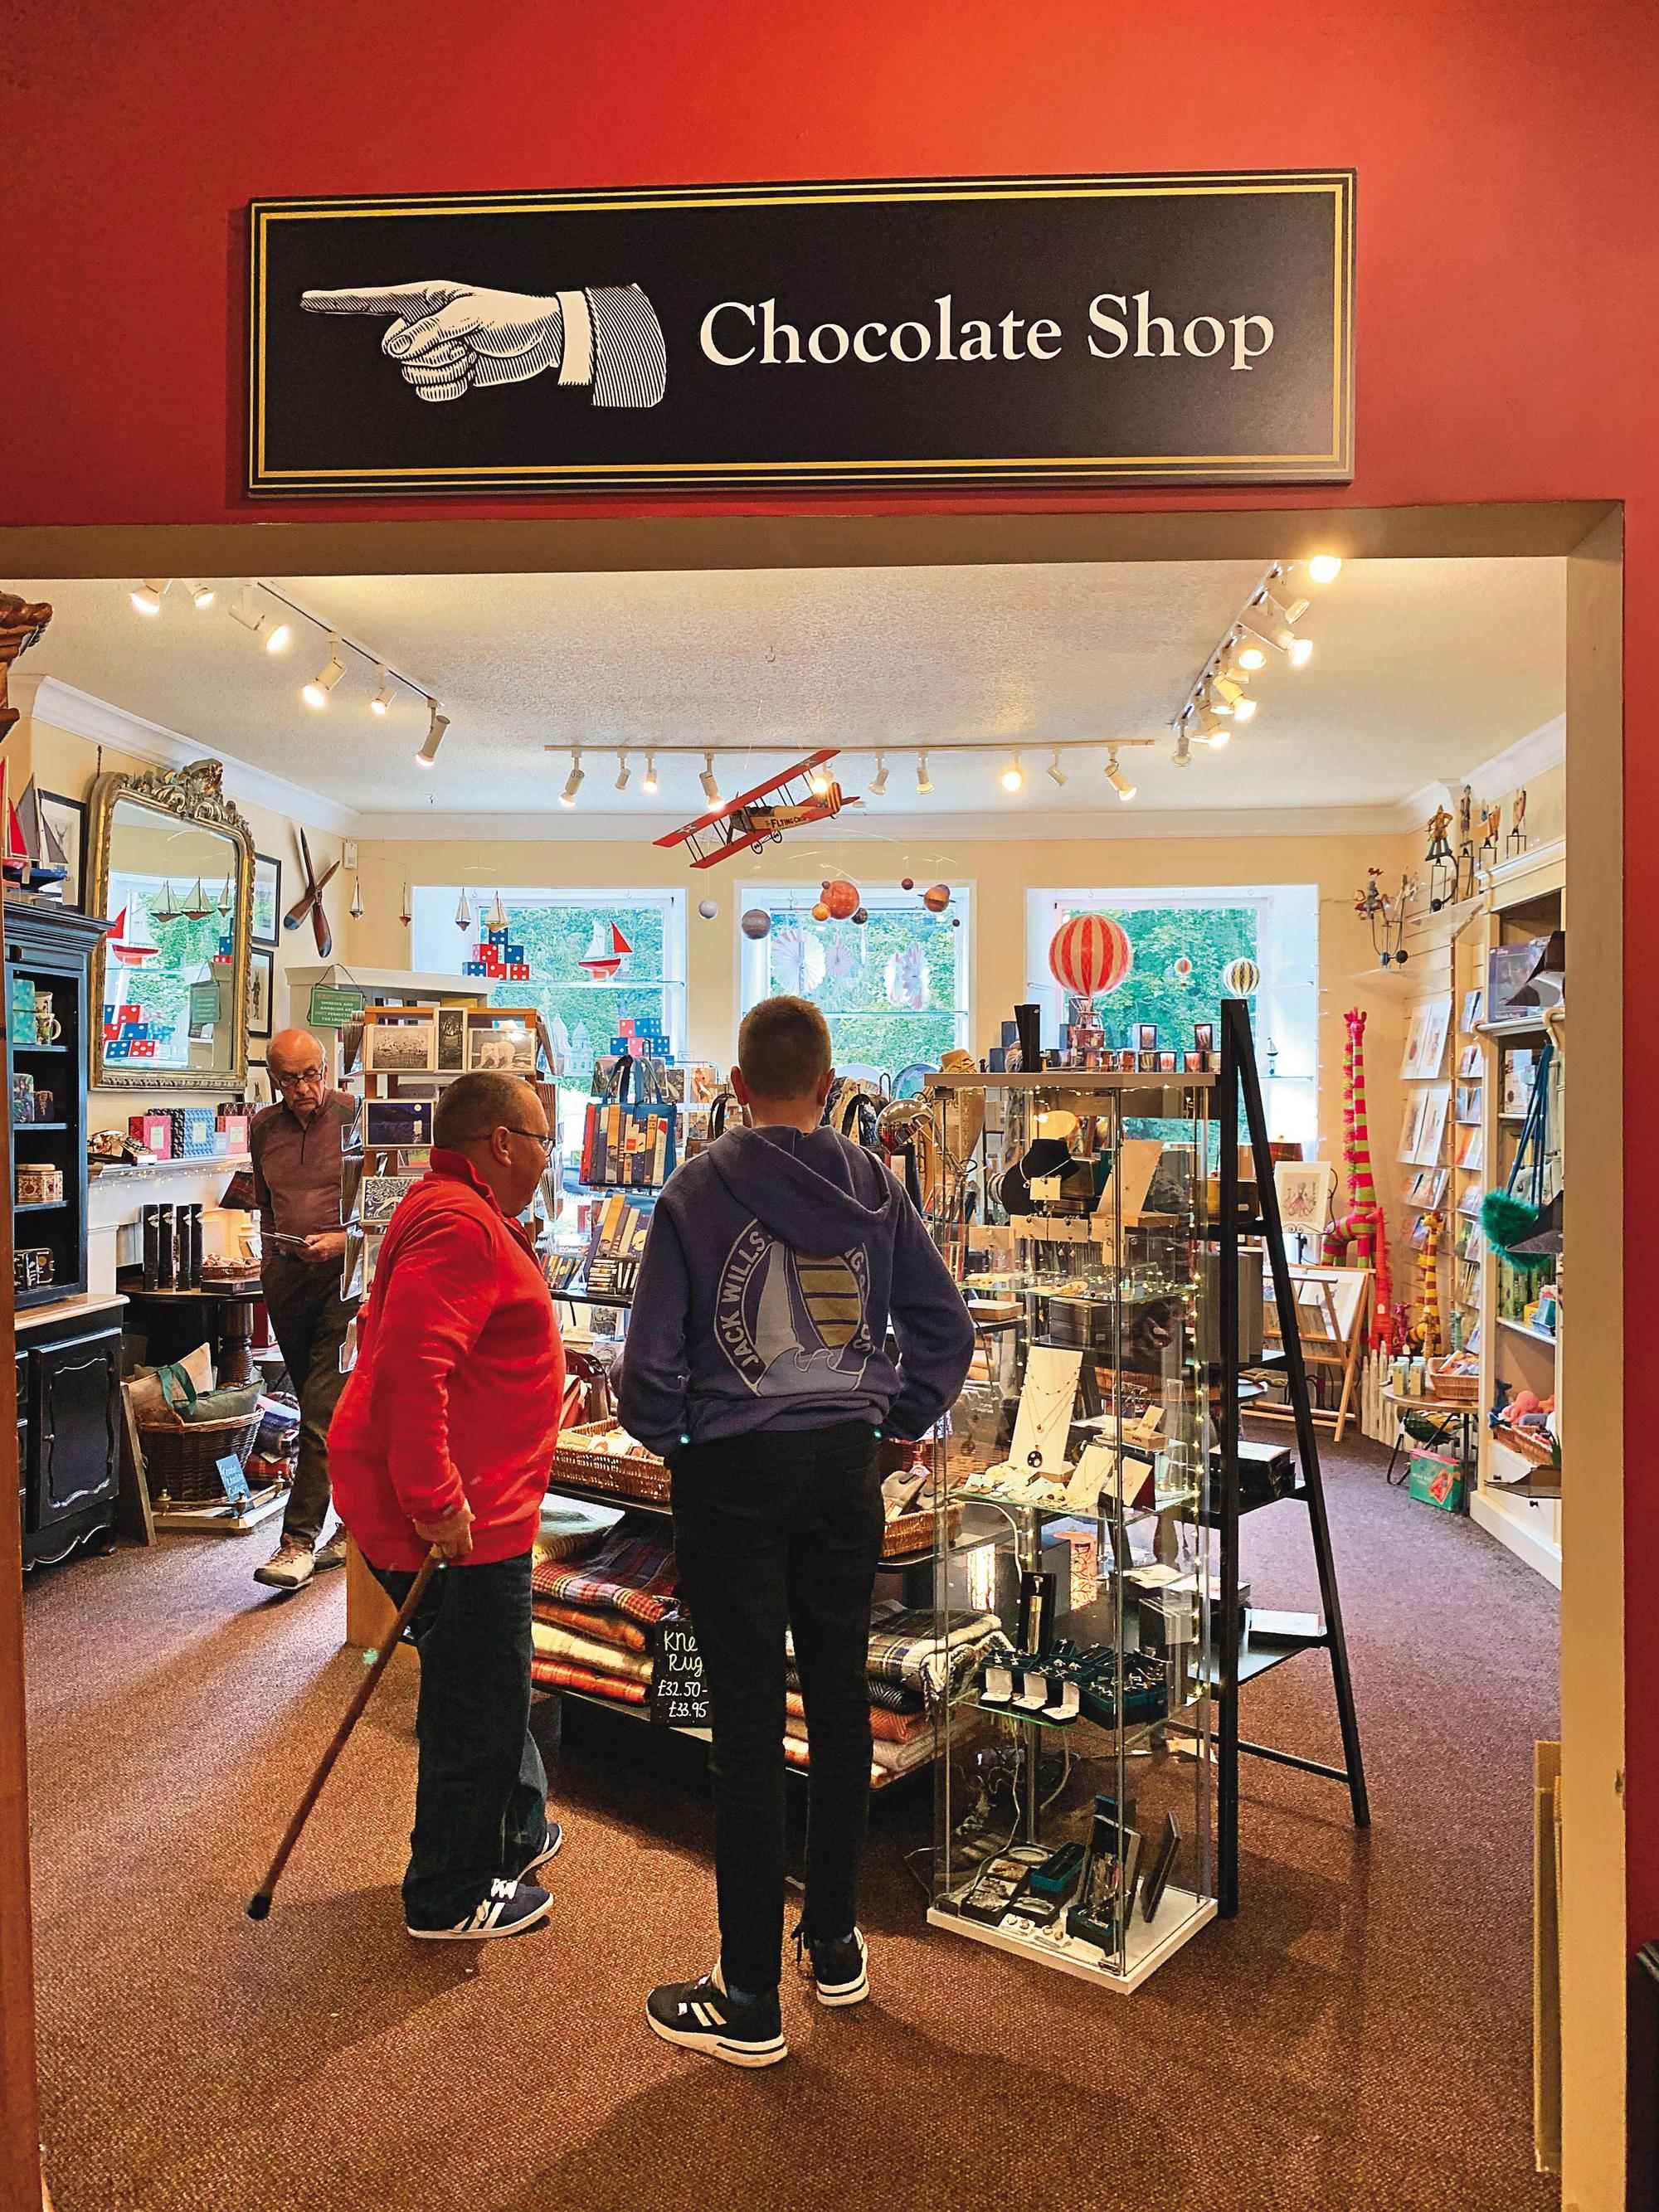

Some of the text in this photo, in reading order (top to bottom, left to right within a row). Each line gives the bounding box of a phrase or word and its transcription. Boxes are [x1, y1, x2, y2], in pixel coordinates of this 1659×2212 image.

[699, 289, 1275, 371] Chocolate Shop
[720, 1231, 766, 1368] JACK WILLS
[664, 1631, 698, 1652] Kne
[669, 1700, 710, 1719] £33.95
